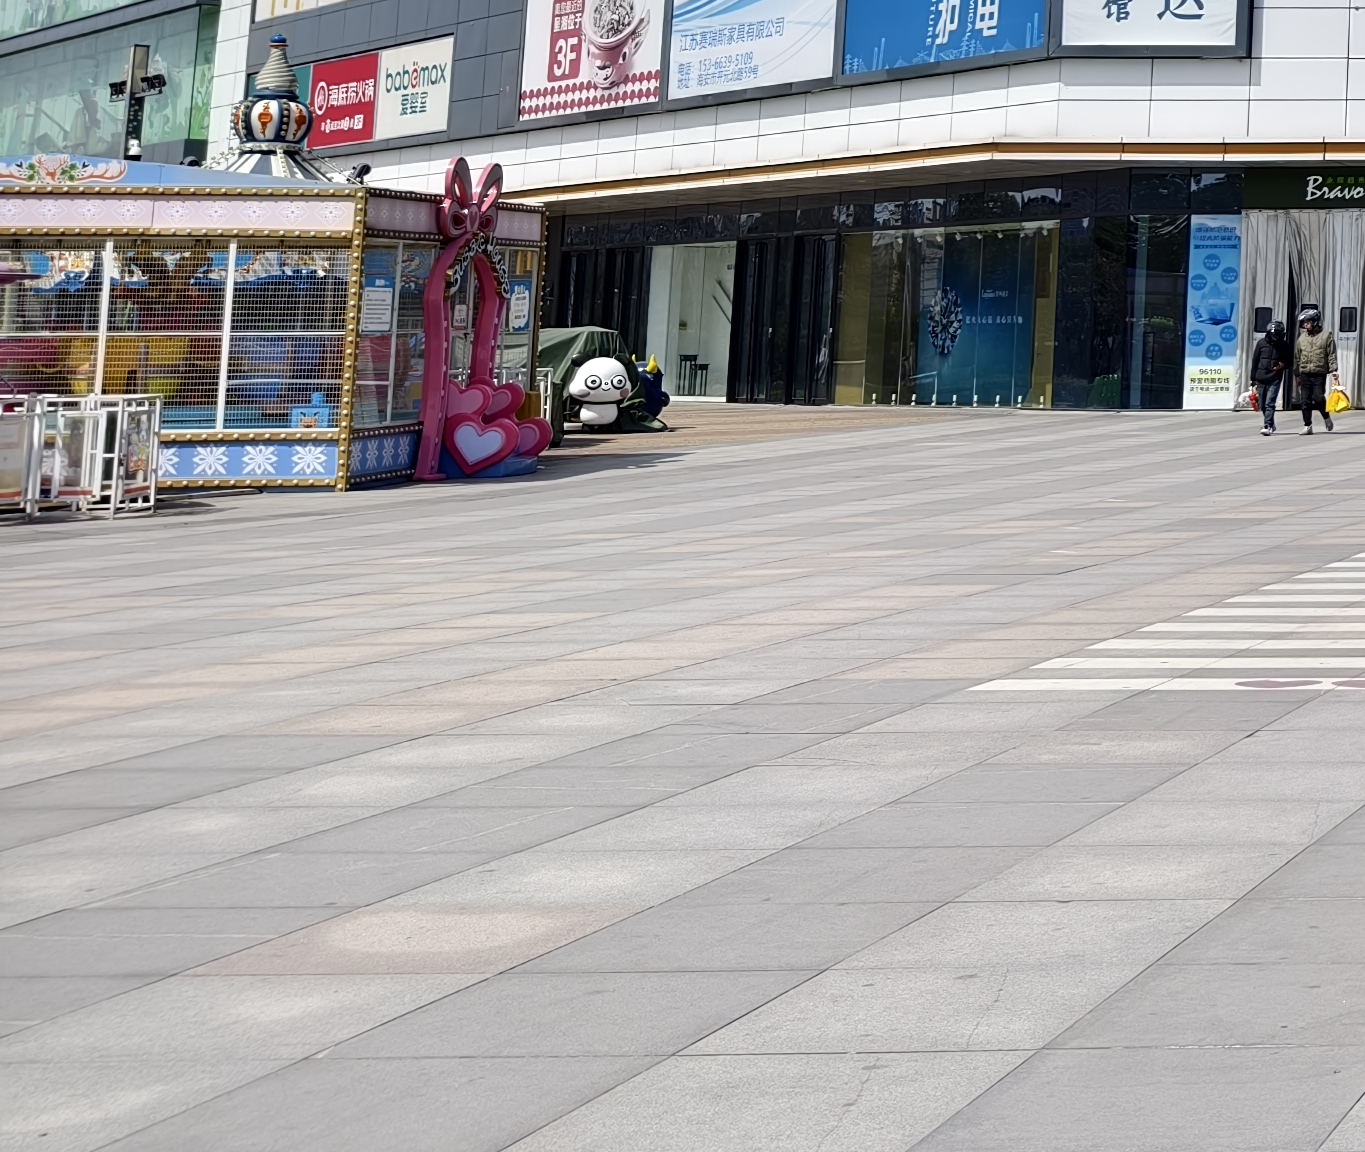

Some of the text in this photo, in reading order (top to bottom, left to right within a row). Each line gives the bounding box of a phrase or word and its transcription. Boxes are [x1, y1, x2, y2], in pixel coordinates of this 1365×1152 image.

[553, 36, 579, 77] 3F
[327, 78, 375, 108] 海底捞火锅
[1305, 175, 1365, 201] Bravo
